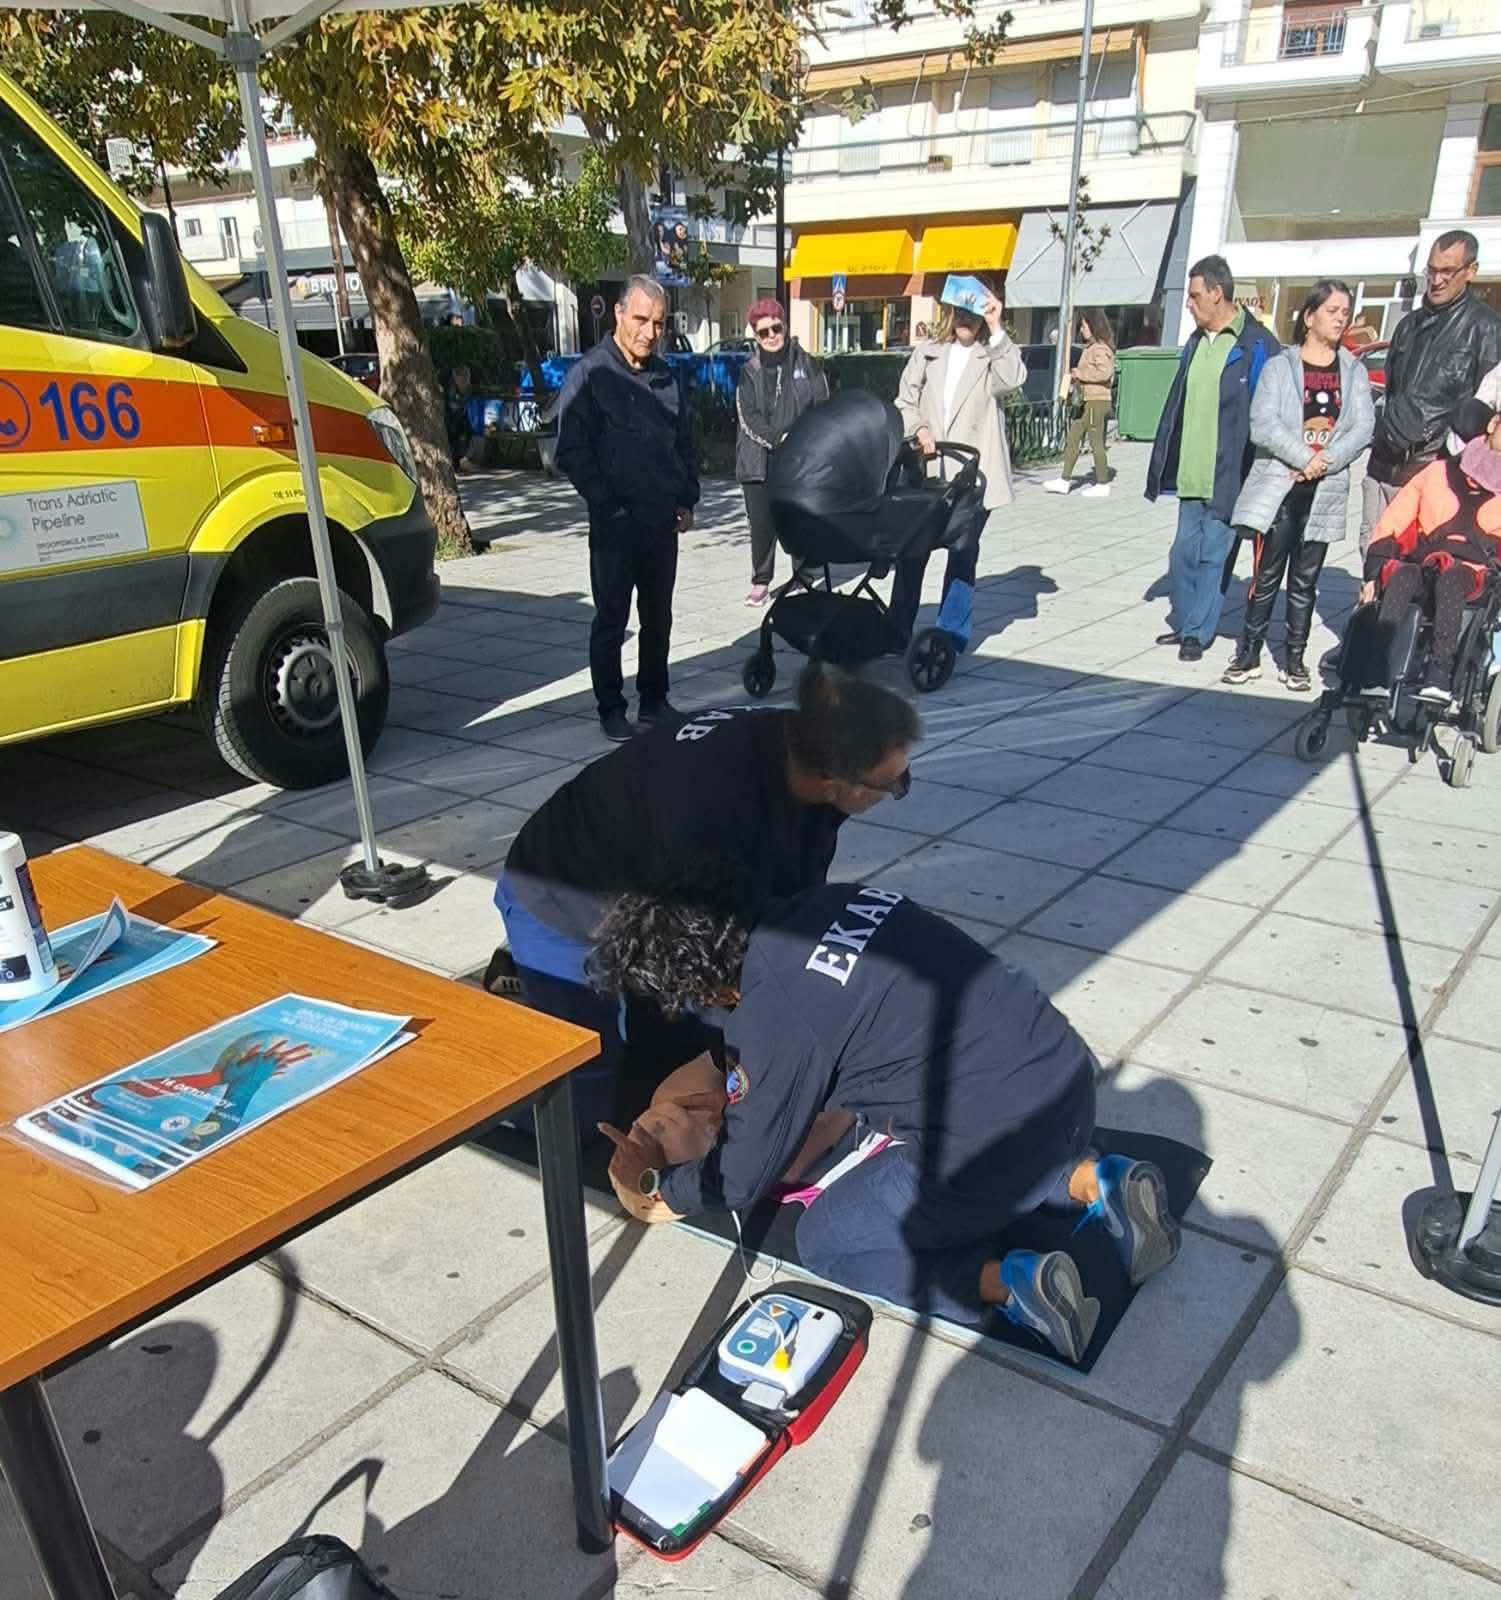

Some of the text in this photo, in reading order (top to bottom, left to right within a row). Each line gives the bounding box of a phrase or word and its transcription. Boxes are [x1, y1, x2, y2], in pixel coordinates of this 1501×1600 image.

[311, 278, 360, 293] BRUO
[39, 382, 141, 441] 166
[26, 488, 119, 513] Trans Adriatic
[32, 513, 86, 532] Pipeline
